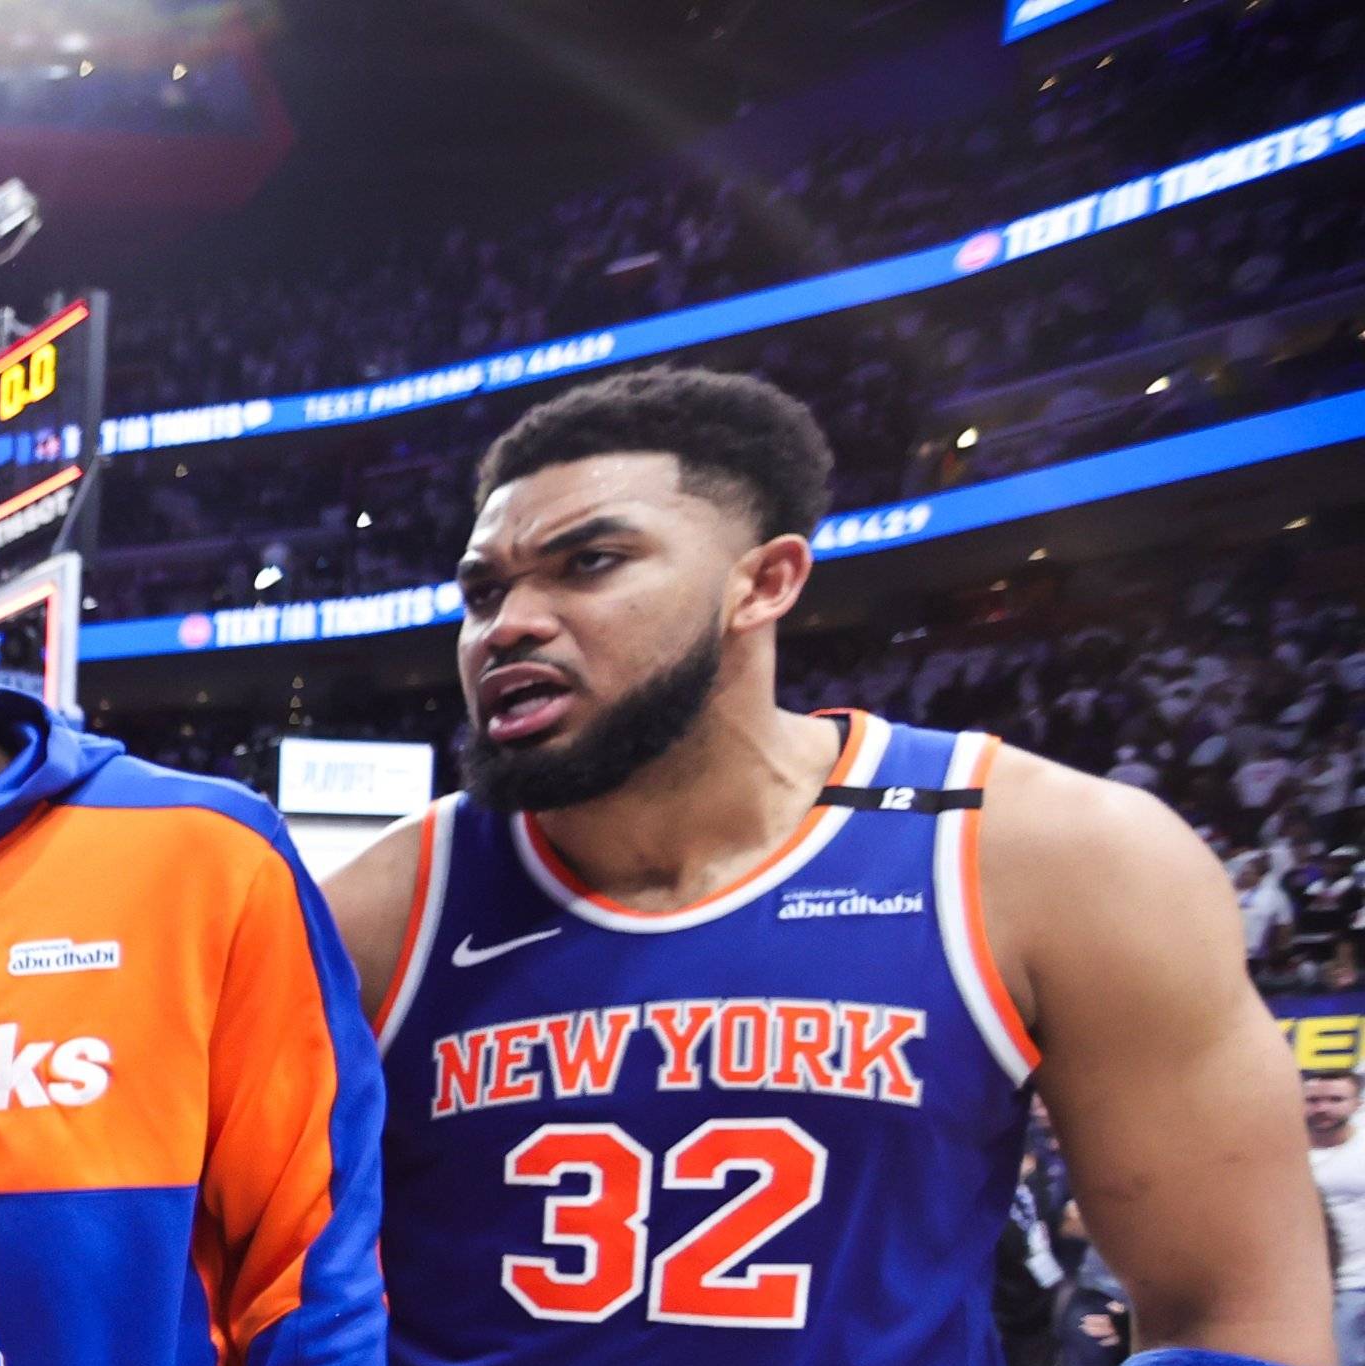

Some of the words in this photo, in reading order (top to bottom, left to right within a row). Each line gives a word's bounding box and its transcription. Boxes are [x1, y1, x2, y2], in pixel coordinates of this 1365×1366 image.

[1002, 196, 1100, 259] TEXT
[1156, 119, 1333, 208] TICKETS
[0, 343, 56, 421] 0.0
[304, 392, 366, 422] TEXT
[369, 364, 484, 412] PISTONS
[488, 355, 524, 384] TO
[879, 787, 915, 810] 12
[778, 899, 836, 920] abu
[837, 891, 924, 915] dhabi
[12, 955, 51, 971] abu
[55, 946, 115, 967] dhabi
[430, 1004, 639, 1120] NEW
[645, 998, 927, 1108] YORK
[501, 1117, 829, 1330] 32
